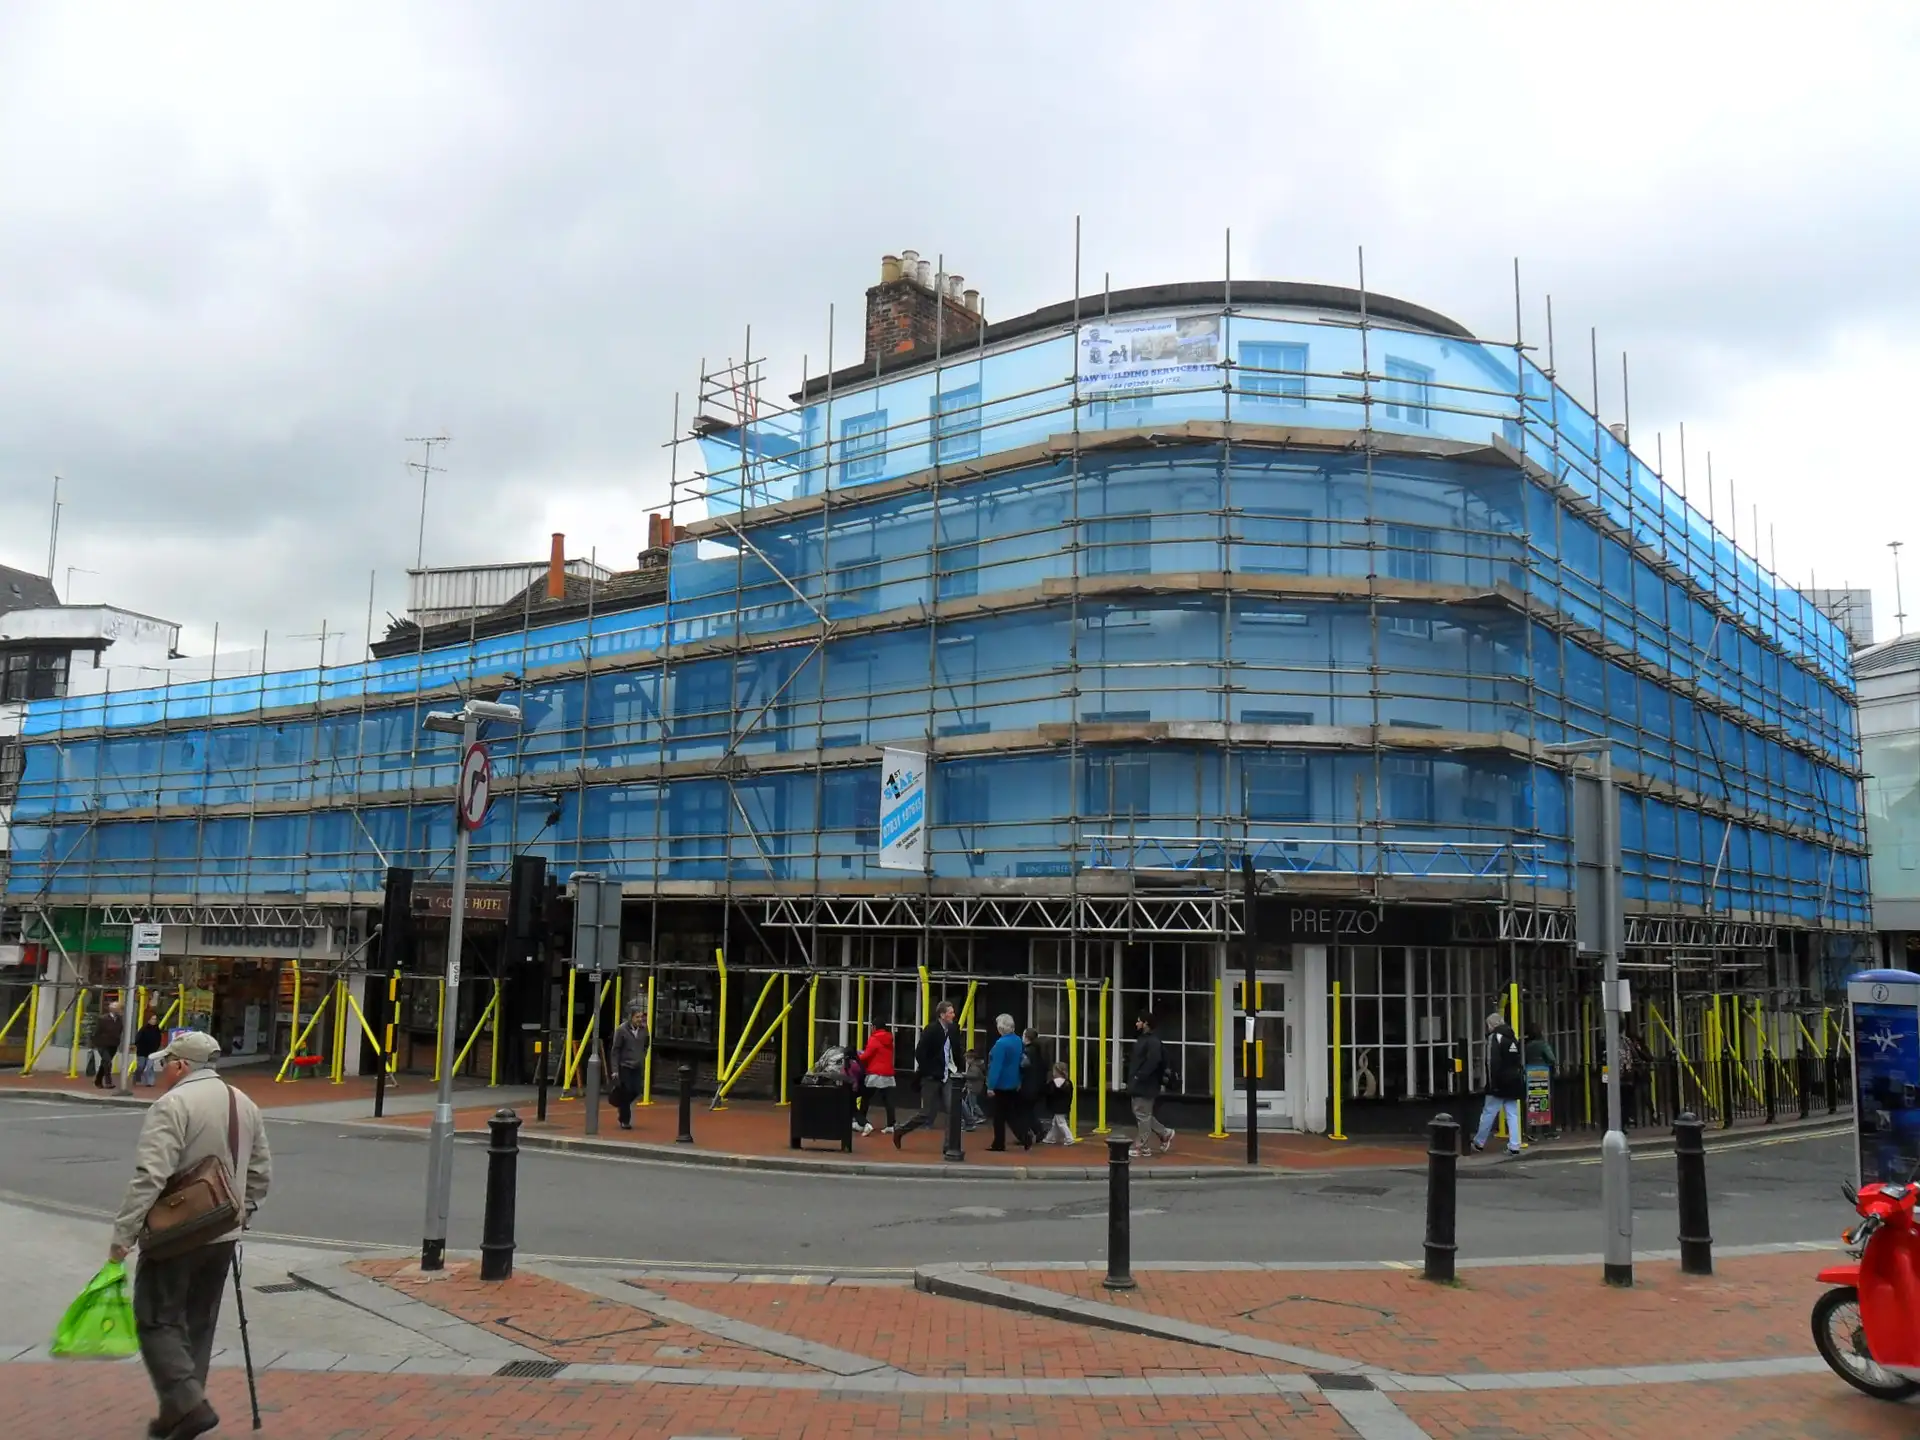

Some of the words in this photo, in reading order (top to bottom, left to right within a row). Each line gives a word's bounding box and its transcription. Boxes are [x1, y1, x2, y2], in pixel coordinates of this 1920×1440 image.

[1101, 369, 1149, 380] BUILDING
[1151, 364, 1198, 376] SERVICES
[472, 897, 502, 910] HOTEL
[1291, 908, 1378, 934] PREZZO
[201, 925, 316, 949] mothercare
